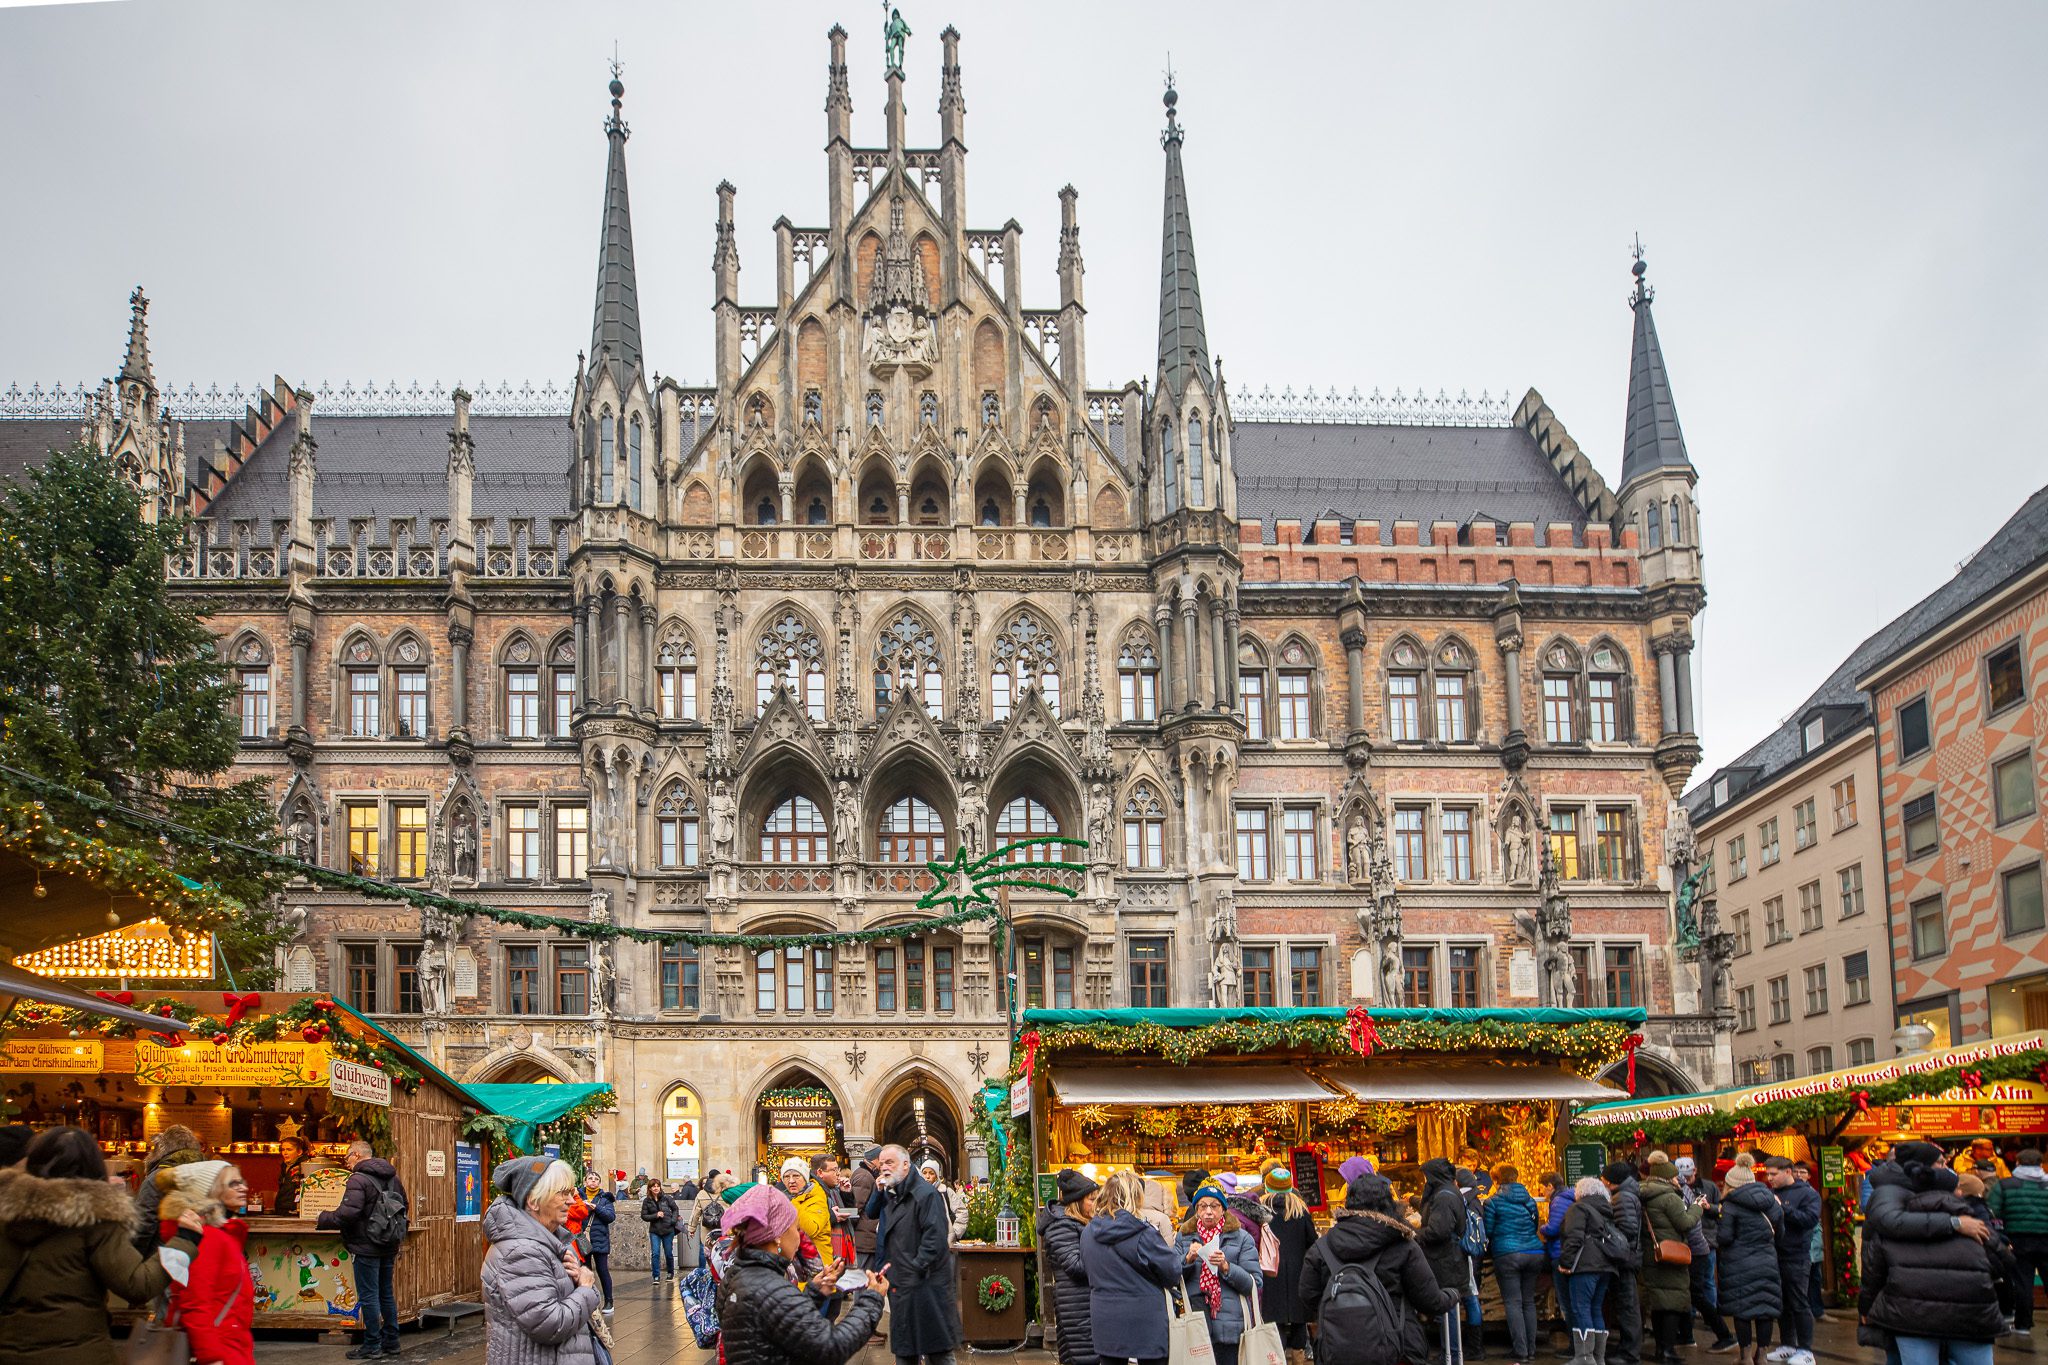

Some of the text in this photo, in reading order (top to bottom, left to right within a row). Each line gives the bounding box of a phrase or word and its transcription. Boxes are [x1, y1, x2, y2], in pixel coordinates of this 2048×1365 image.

[195, 1046, 221, 1063] nach
[225, 1048, 304, 1064] Großmutterart
[334, 1063, 387, 1090] Glühwein
[1752, 1080, 1829, 1106] Glühwein
[1830, 1075, 1843, 1091] &
[1843, 1064, 1900, 1088] Punsch
[1905, 1055, 1943, 1075] nach
[333, 1082, 348, 1093] nach
[1990, 1084, 2033, 1101] Alm
[773, 1111, 822, 1119] RESTAURANT
